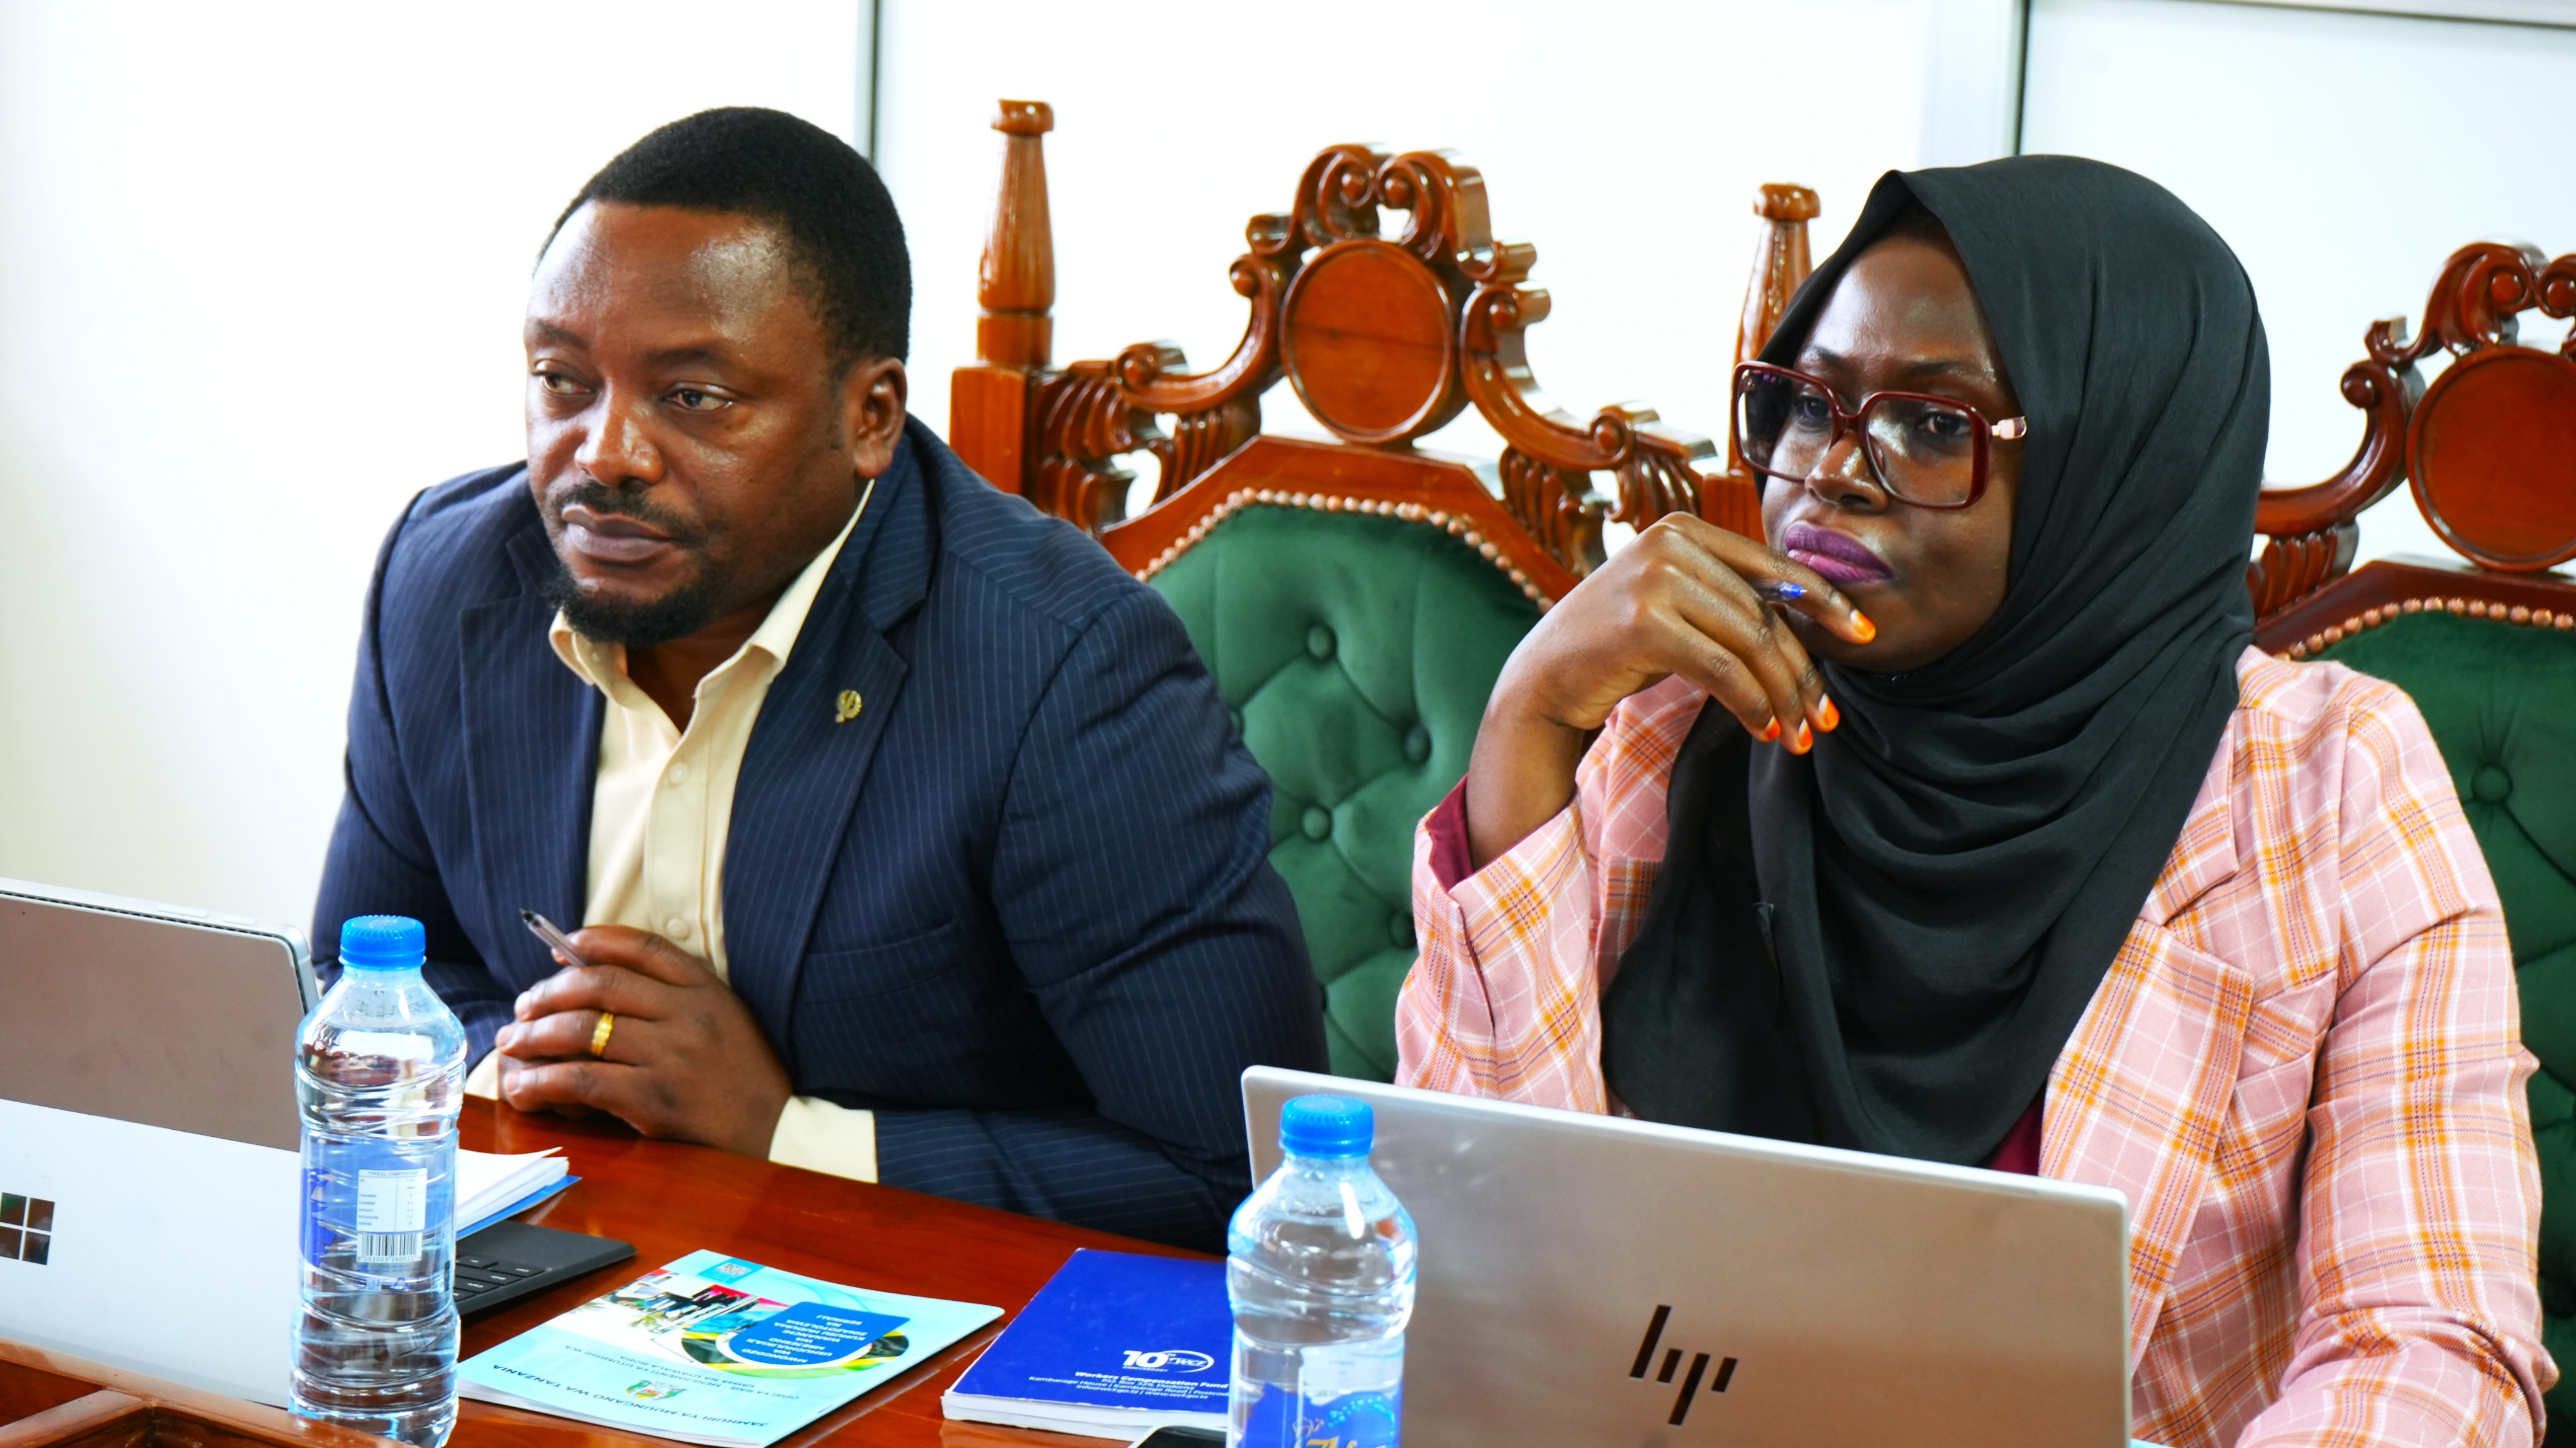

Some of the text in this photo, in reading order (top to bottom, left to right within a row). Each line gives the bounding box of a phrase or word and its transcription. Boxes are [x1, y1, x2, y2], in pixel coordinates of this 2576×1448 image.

[816, 1314, 863, 1325] SERIKALI
[774, 1322, 866, 1341] KUHUSU HUDUMA
[786, 1319, 869, 1337] ZINAZOTOLEWA
[782, 1330, 841, 1342] WANANCHI
[745, 1338, 833, 1357] USHUGHULIKIAJI
[769, 1337, 826, 1351] MREJESHO
[584, 1351, 634, 1368] UTUMISHI
[619, 1355, 649, 1366] BORA
[741, 1348, 808, 1363] MWONGOZO
[1123, 1350, 1169, 1368] 10
[1169, 1357, 1208, 1367] WCF
[652, 1364, 702, 1379] UTAWALA
[1629, 1304, 1738, 1426] hp
[650, 1369, 721, 1388] MENEJIMENTI
[722, 1380, 755, 1388] UMMA
[1028, 1376, 1079, 1384] Kambarage
[1113, 1383, 1163, 1392] Kambarage
[1075, 1371, 1119, 1379] Workers
[1121, 1375, 1199, 1386] Compensation
[493, 1364, 769, 1427] JAMHURI YA MUUNGANO WA TANZANIA
